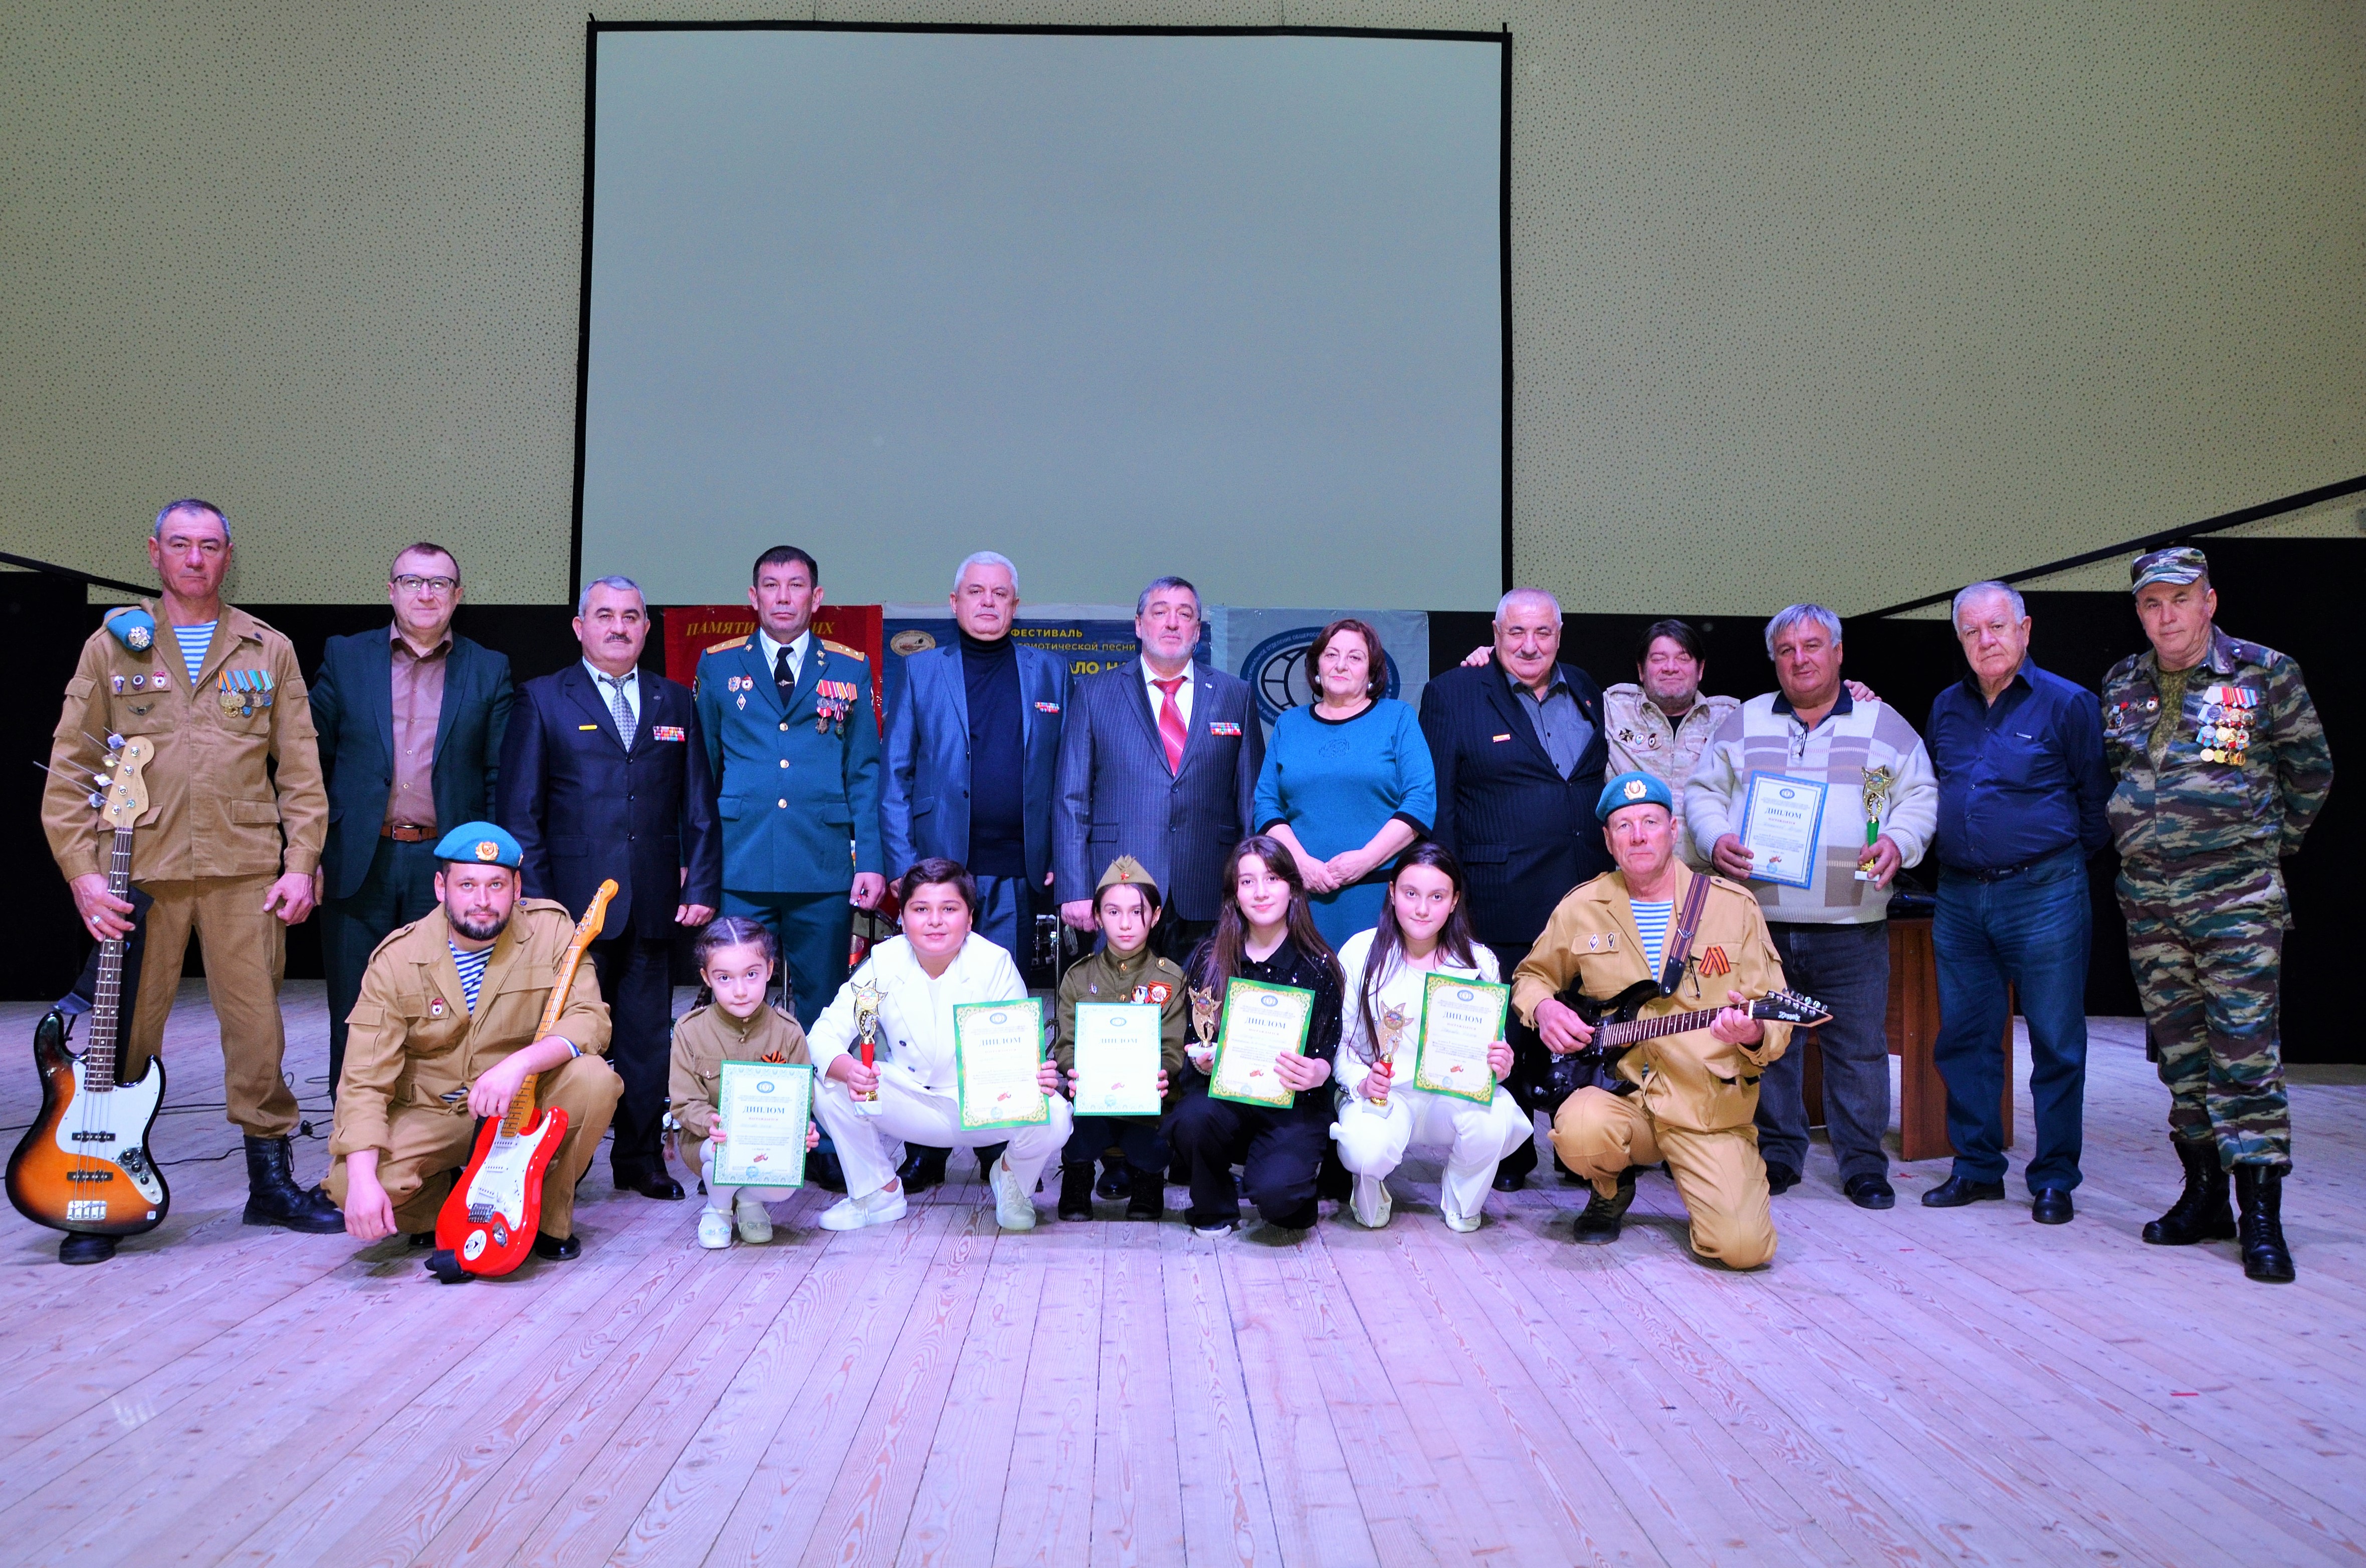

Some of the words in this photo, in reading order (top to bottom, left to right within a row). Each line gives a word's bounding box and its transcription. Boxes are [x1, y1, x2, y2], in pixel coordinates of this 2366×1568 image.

[686, 621, 756, 636] ПАМЯТИ
[1010, 628, 1083, 637] ФЕСТИВАЛЬ
[1102, 643, 1136, 651] песни
[1765, 807, 1802, 819] ДИПЛОМ
[1244, 1016, 1285, 1029] ДИПЛОМ
[1442, 1011, 1482, 1024] ДИПЛОМ
[978, 1037, 1020, 1047] ДИПЛОМ
[742, 1105, 785, 1114] ДИПЛОМ
